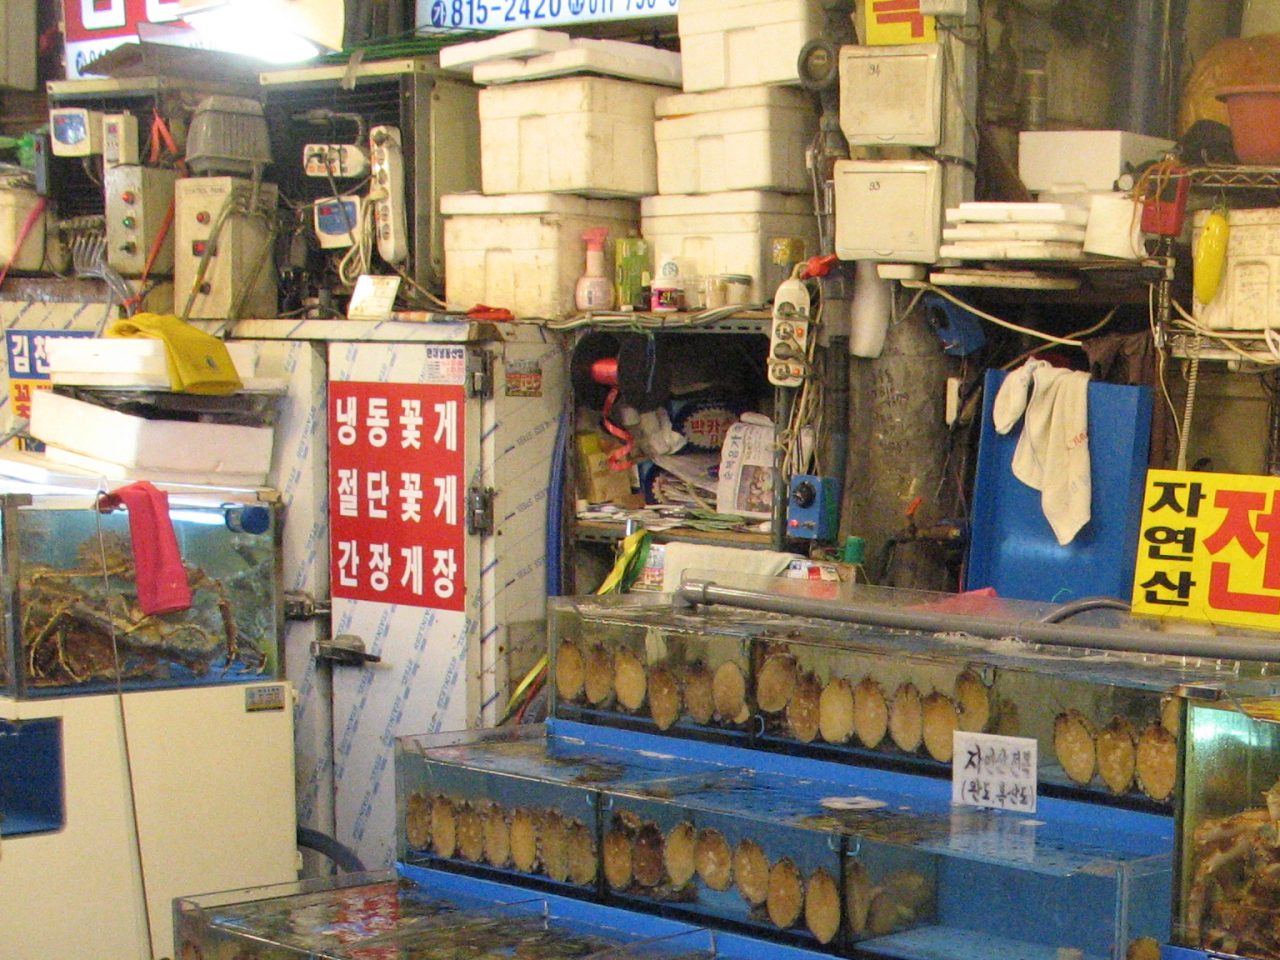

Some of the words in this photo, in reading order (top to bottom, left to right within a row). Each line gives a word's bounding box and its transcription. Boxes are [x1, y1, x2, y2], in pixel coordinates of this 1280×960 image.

[335, 396, 458, 452] 냉동꽃게
[337, 468, 458, 526] 절단꽃게
[337, 539, 459, 600] 간장게장
[1140, 482, 1206, 607] 자연산
